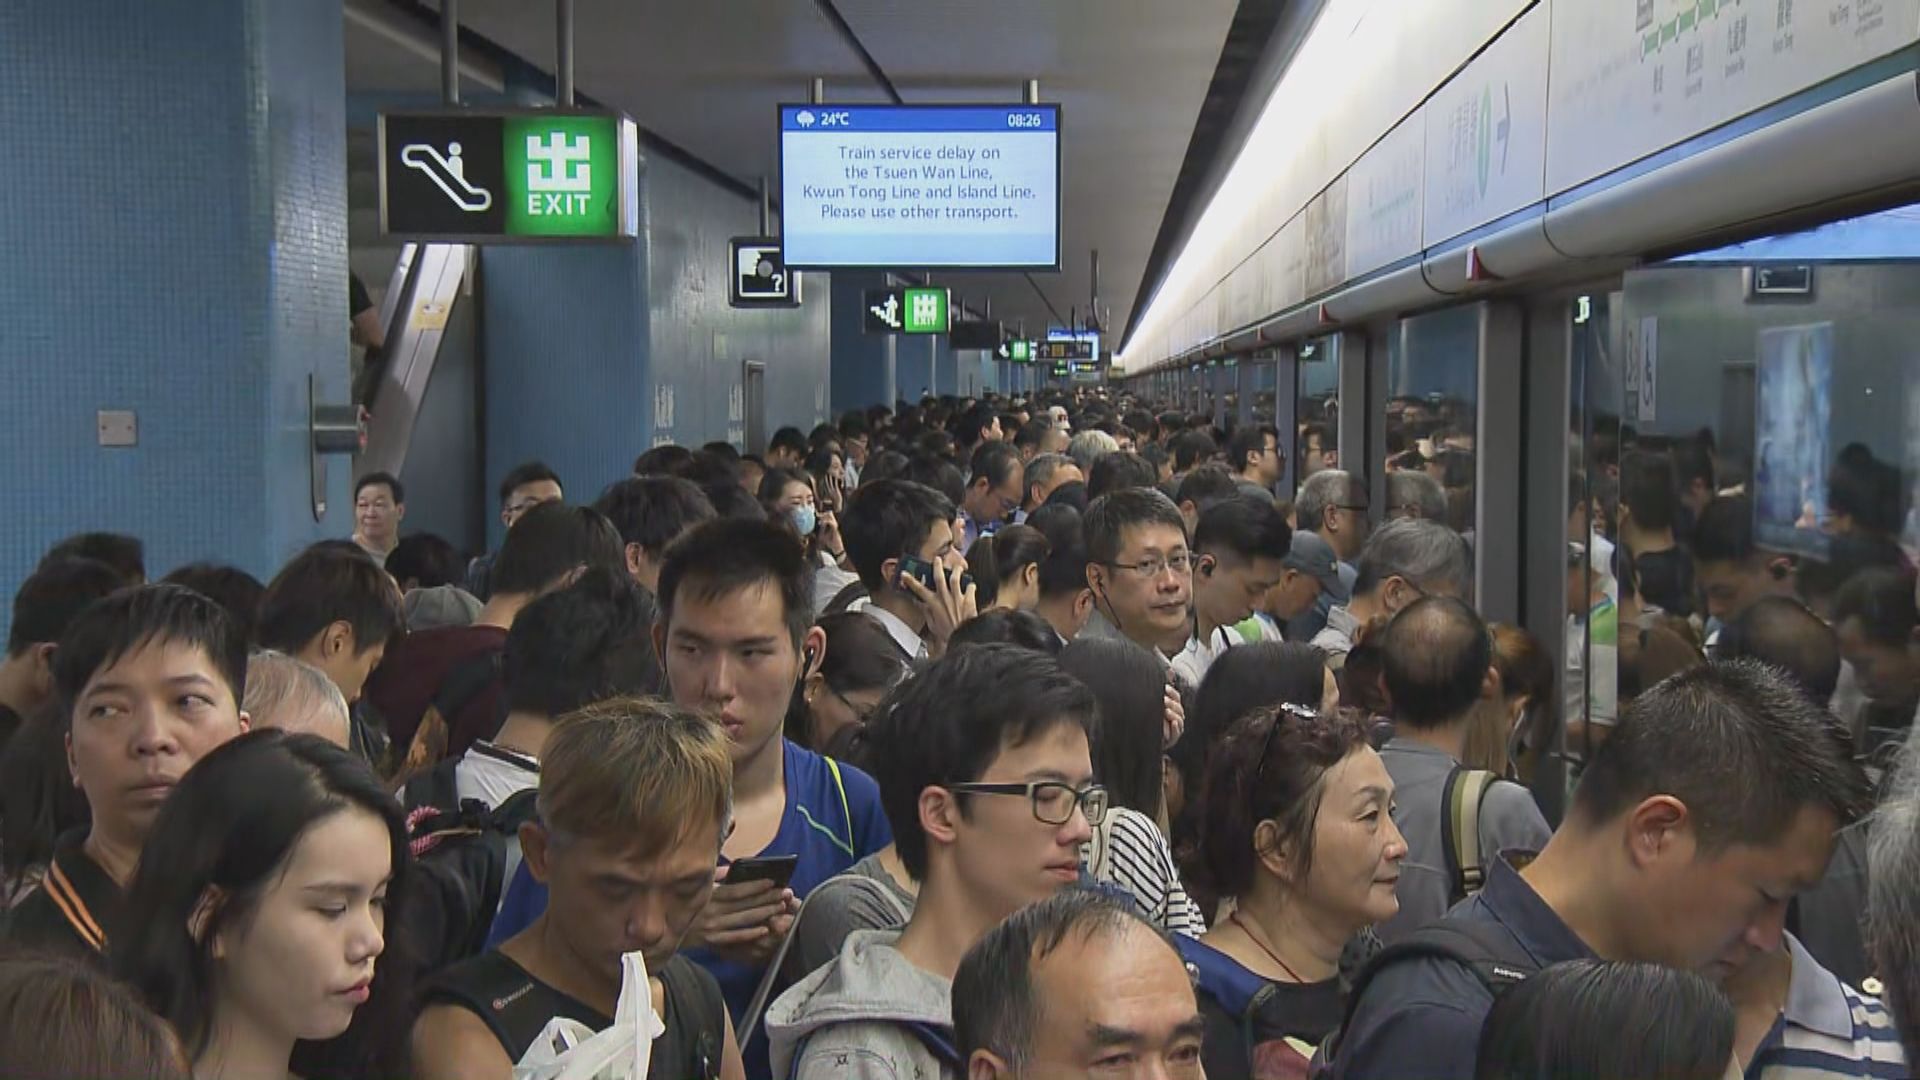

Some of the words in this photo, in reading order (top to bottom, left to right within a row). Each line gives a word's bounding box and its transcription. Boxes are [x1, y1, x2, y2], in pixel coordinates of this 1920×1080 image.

[820, 111, 849, 126] 24°C
[1007, 113, 1041, 127] 08:26
[527, 132, 591, 191] 出
[838, 145, 876, 159] Train
[880, 145, 932, 160] service
[936, 144, 976, 163] delay
[981, 148, 1001, 160] on
[845, 165, 869, 179] the
[873, 165, 918, 179] Tsuen
[922, 165, 956, 179] Wan
[960, 164, 993, 181] Line,
[802, 184, 845, 199] Kwun
[848, 184, 887, 202] Tong
[891, 184, 921, 199] Line
[925, 184, 952, 199] and
[957, 183, 998, 199] Island
[1002, 184, 1037, 199] Line.
[527, 193, 592, 216] EXIT
[820, 203, 867, 218] Please
[871, 206, 896, 219] use
[900, 203, 941, 219] other
[945, 205, 1019, 222] transport.
